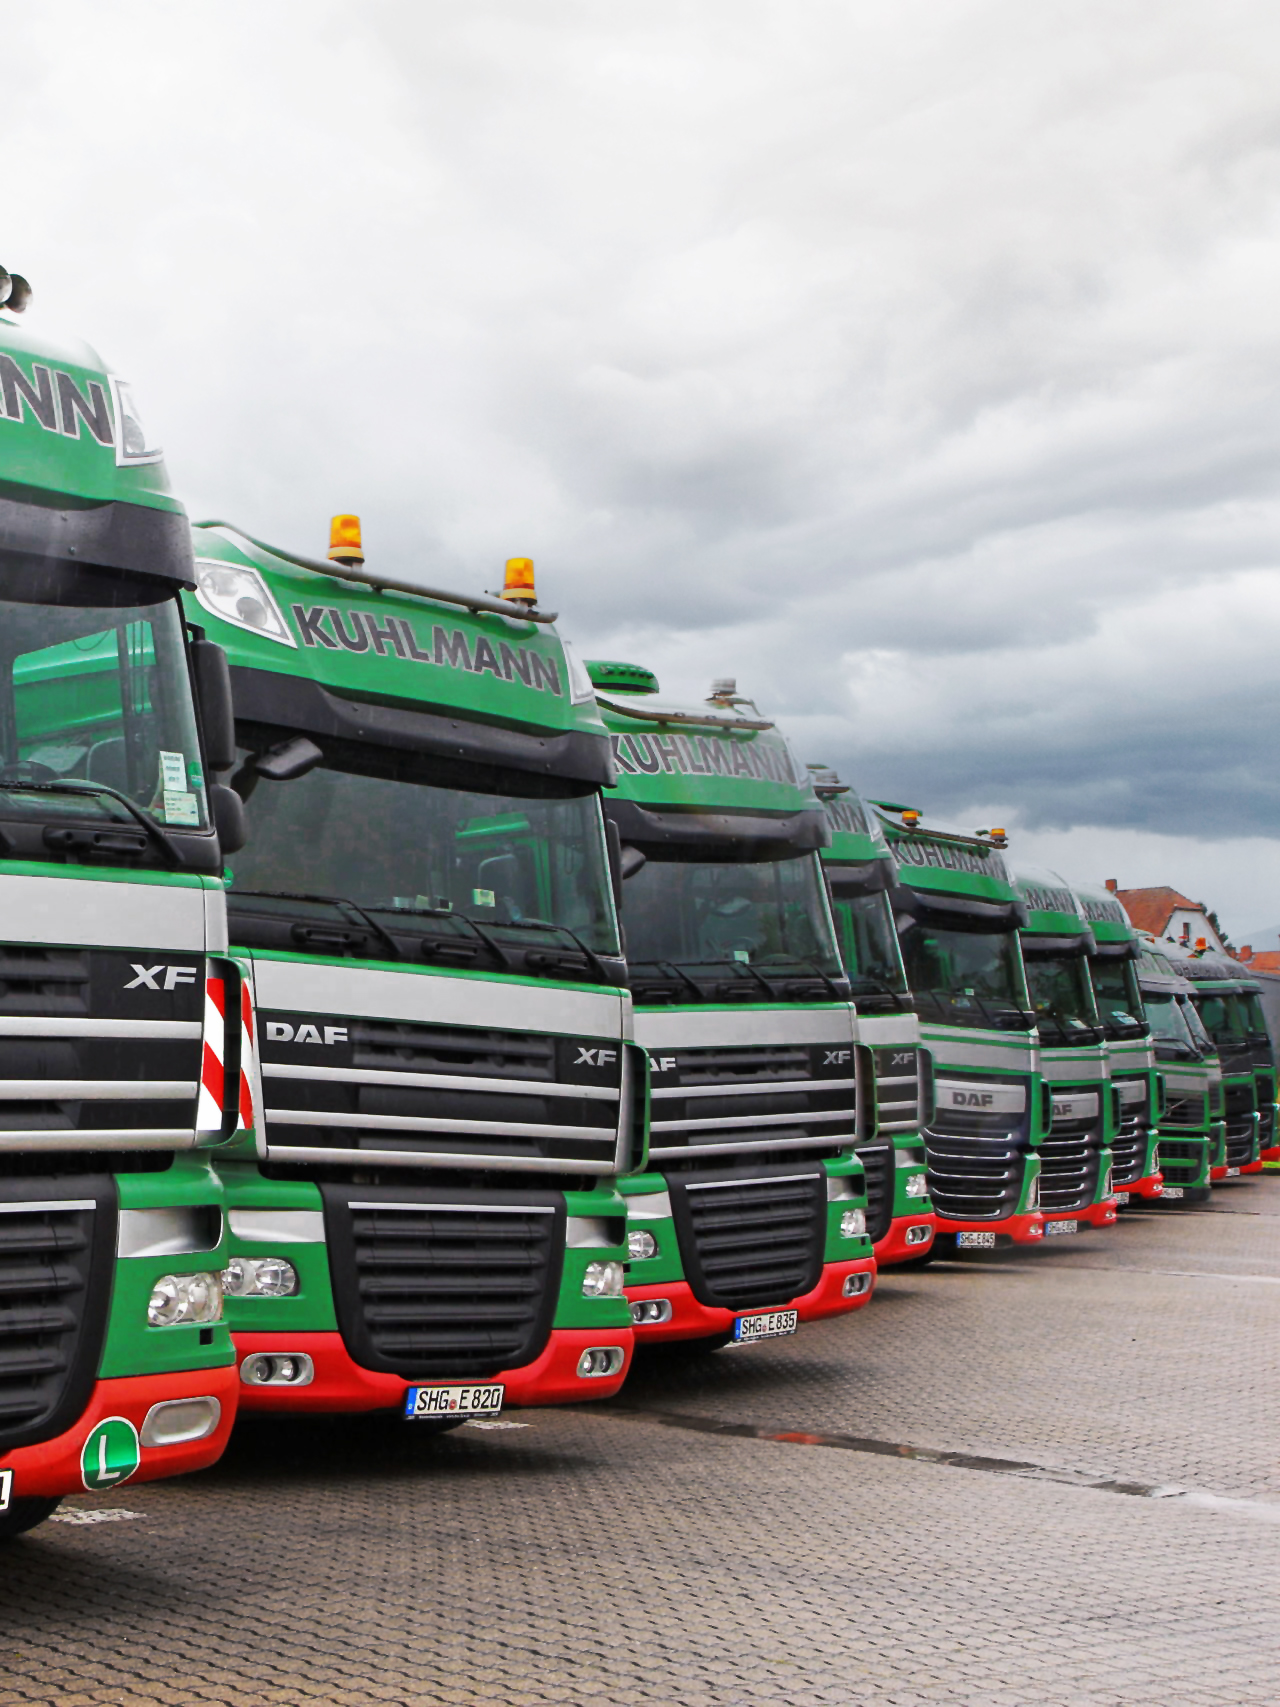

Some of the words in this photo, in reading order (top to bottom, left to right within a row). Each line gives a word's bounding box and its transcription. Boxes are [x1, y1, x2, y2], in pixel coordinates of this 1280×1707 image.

[291, 603, 563, 697] KUHLMANN
[610, 733, 799, 785] KUHLMANN
[884, 837, 1009, 882] KUHLMANN
[123, 964, 197, 991] XF
[266, 1022, 348, 1045] DAF
[573, 1047, 617, 1067] XF
[648, 1057, 676, 1072] AF
[822, 1050, 851, 1065] XF
[891, 1052, 914, 1065] XF
[952, 1091, 993, 1107] DAF
[1053, 1104, 1073, 1116] AF
[741, 1317, 762, 1335] SHG
[768, 1315, 775, 1331] E
[776, 1312, 795, 1330] 835
[416, 1390, 450, 1411] SHG
[459, 1389, 470, 1410] E
[472, 1388, 500, 1410] 820
[98, 1435, 121, 1480] L
